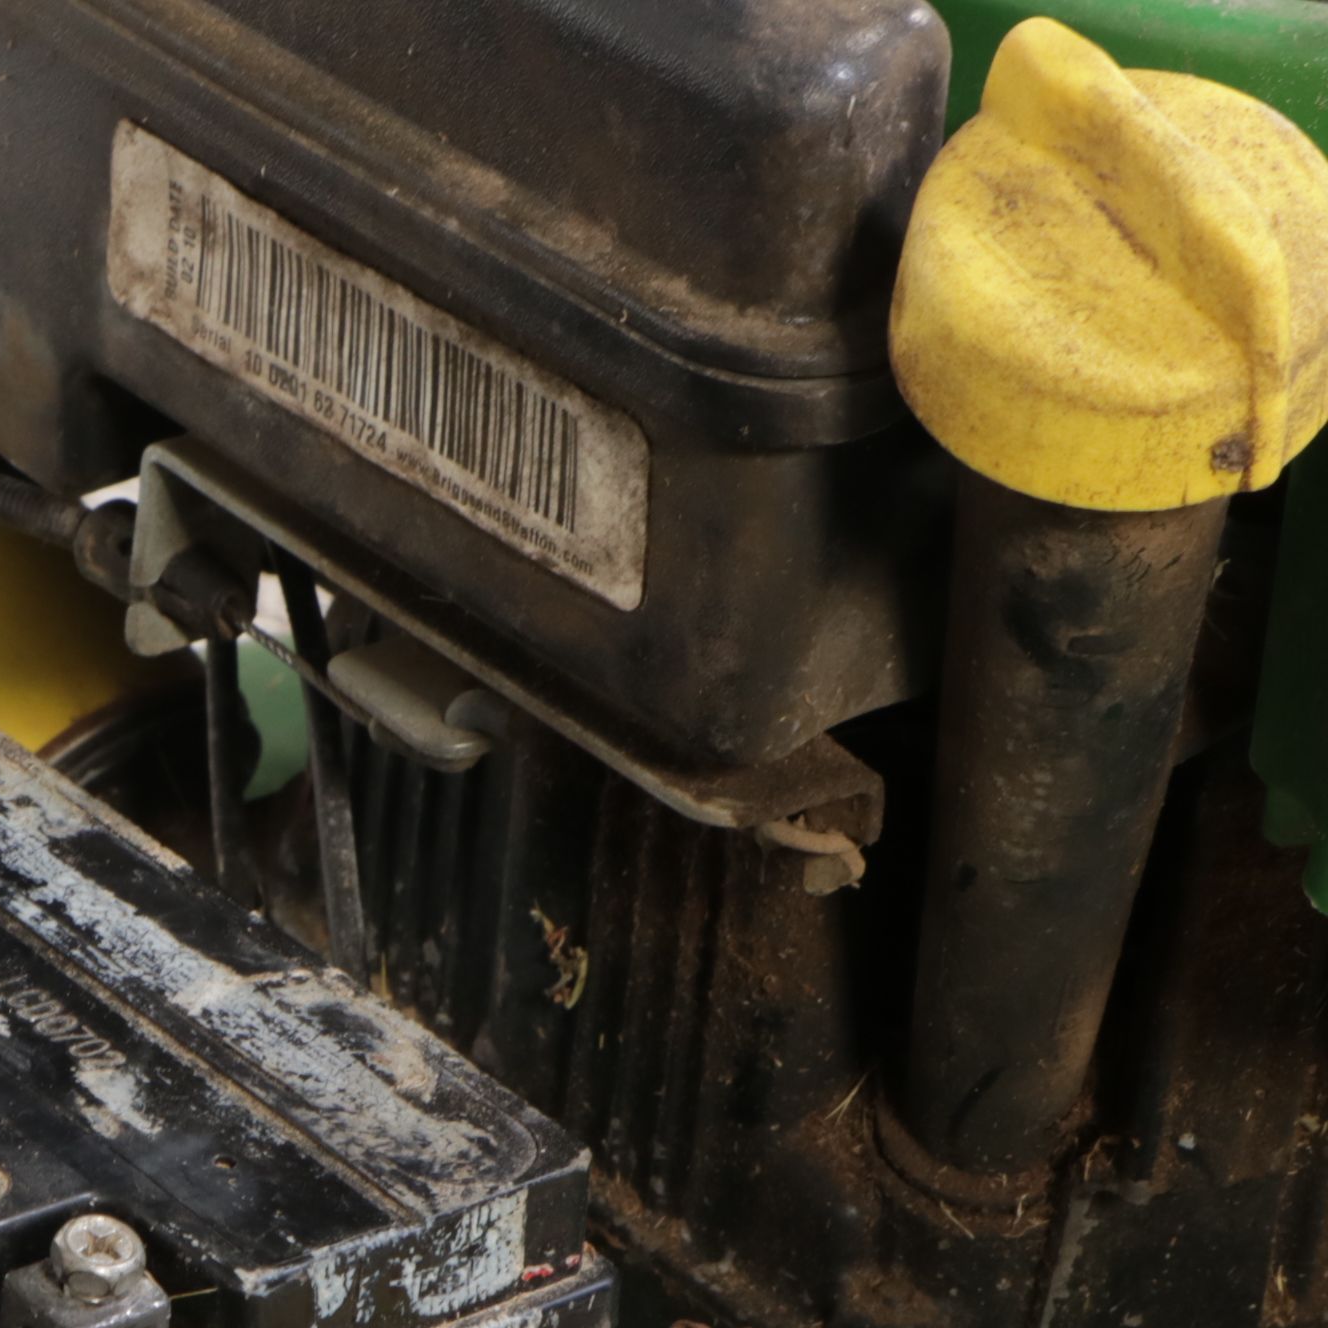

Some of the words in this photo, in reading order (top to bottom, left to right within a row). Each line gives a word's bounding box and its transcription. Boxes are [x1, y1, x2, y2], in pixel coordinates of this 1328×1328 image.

[169, 179, 182, 232] DATE
[183, 226, 197, 248] 10
[164, 237, 178, 301] BUILD
[180, 257, 194, 284] 02
[191, 316, 232, 353] Serial
[244, 348, 263, 377] 10
[340, 404, 388, 454] 71724
